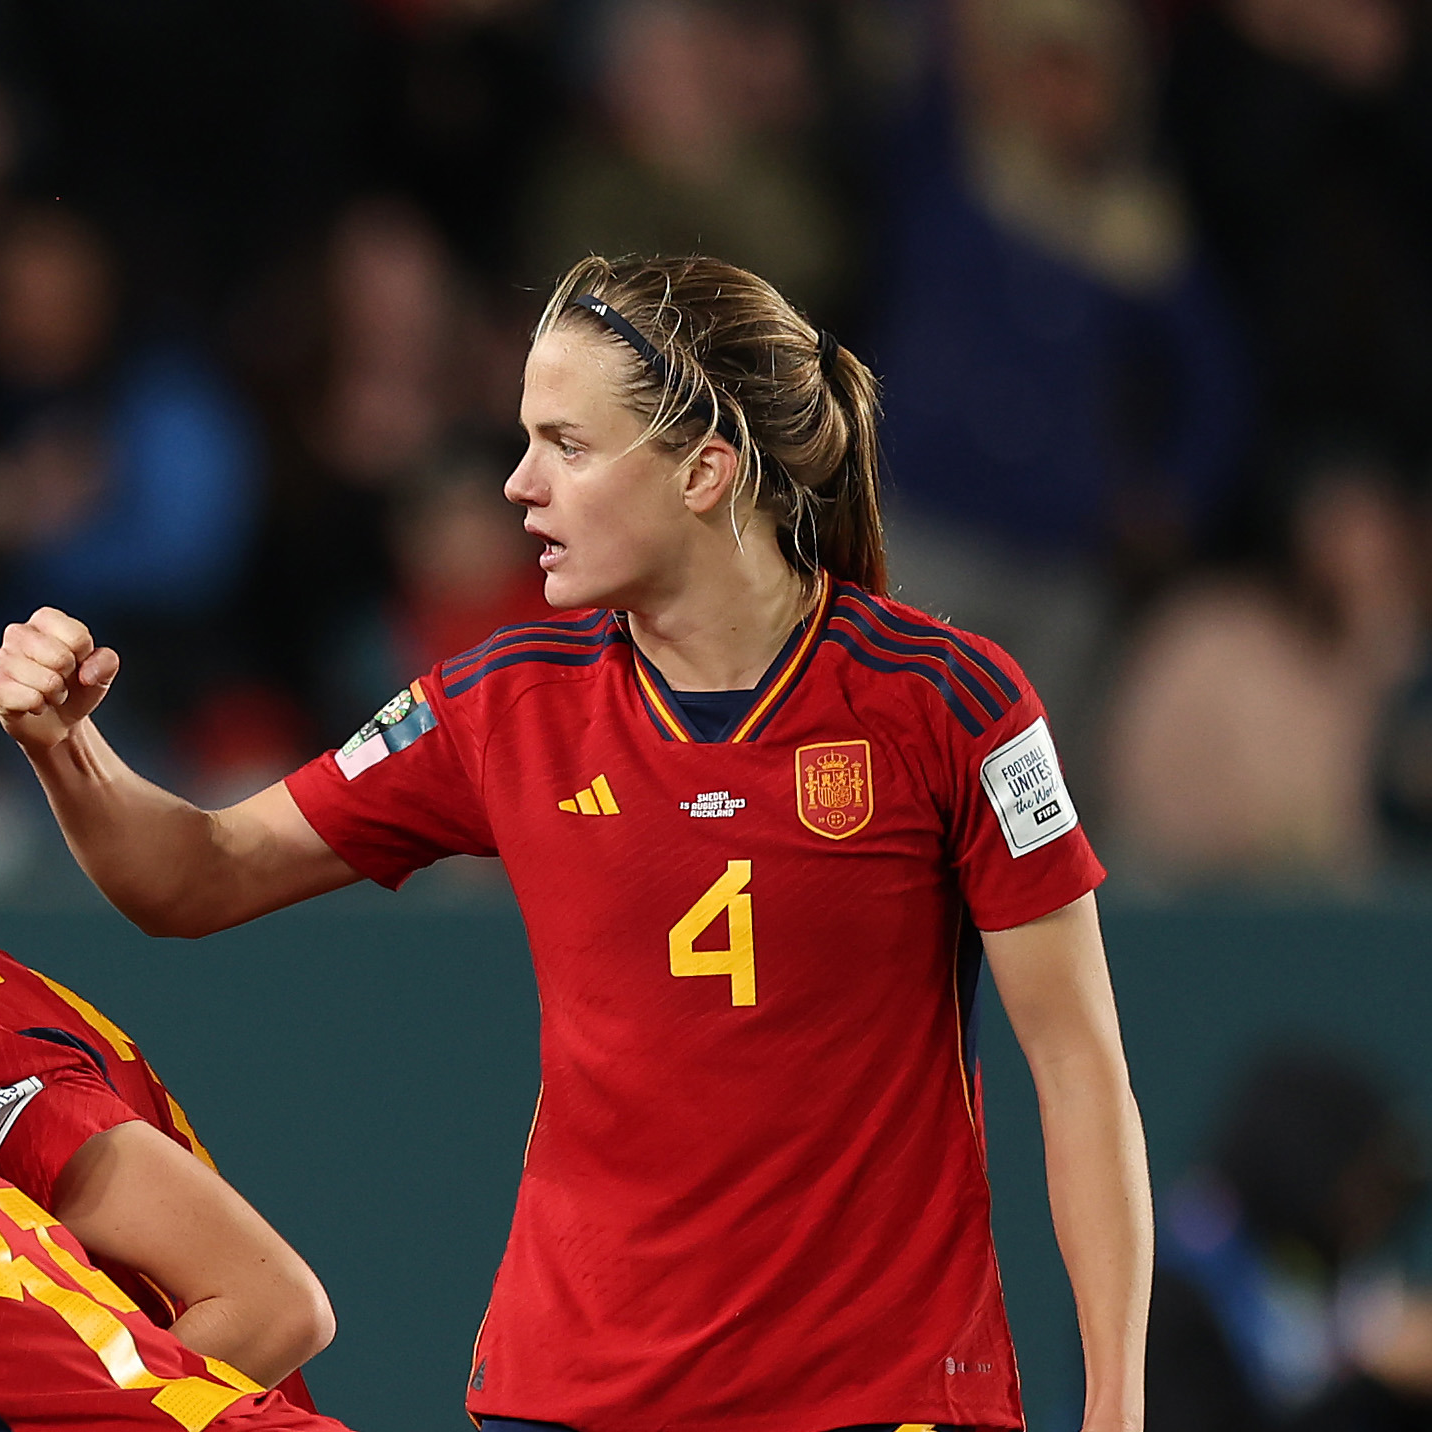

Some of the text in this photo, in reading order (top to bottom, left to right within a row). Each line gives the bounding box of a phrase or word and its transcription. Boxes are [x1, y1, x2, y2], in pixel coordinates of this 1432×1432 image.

[1001, 745, 1045, 780] FOOTBALL
[1008, 759, 1053, 798] UNITES
[691, 800, 724, 810] AUGUST
[724, 798, 746, 809] 2023
[697, 791, 729, 803] SWEDEN
[690, 808, 735, 818] AUCKLAND
[1036, 803, 1059, 822] FIFA
[668, 859, 757, 1008] 4
